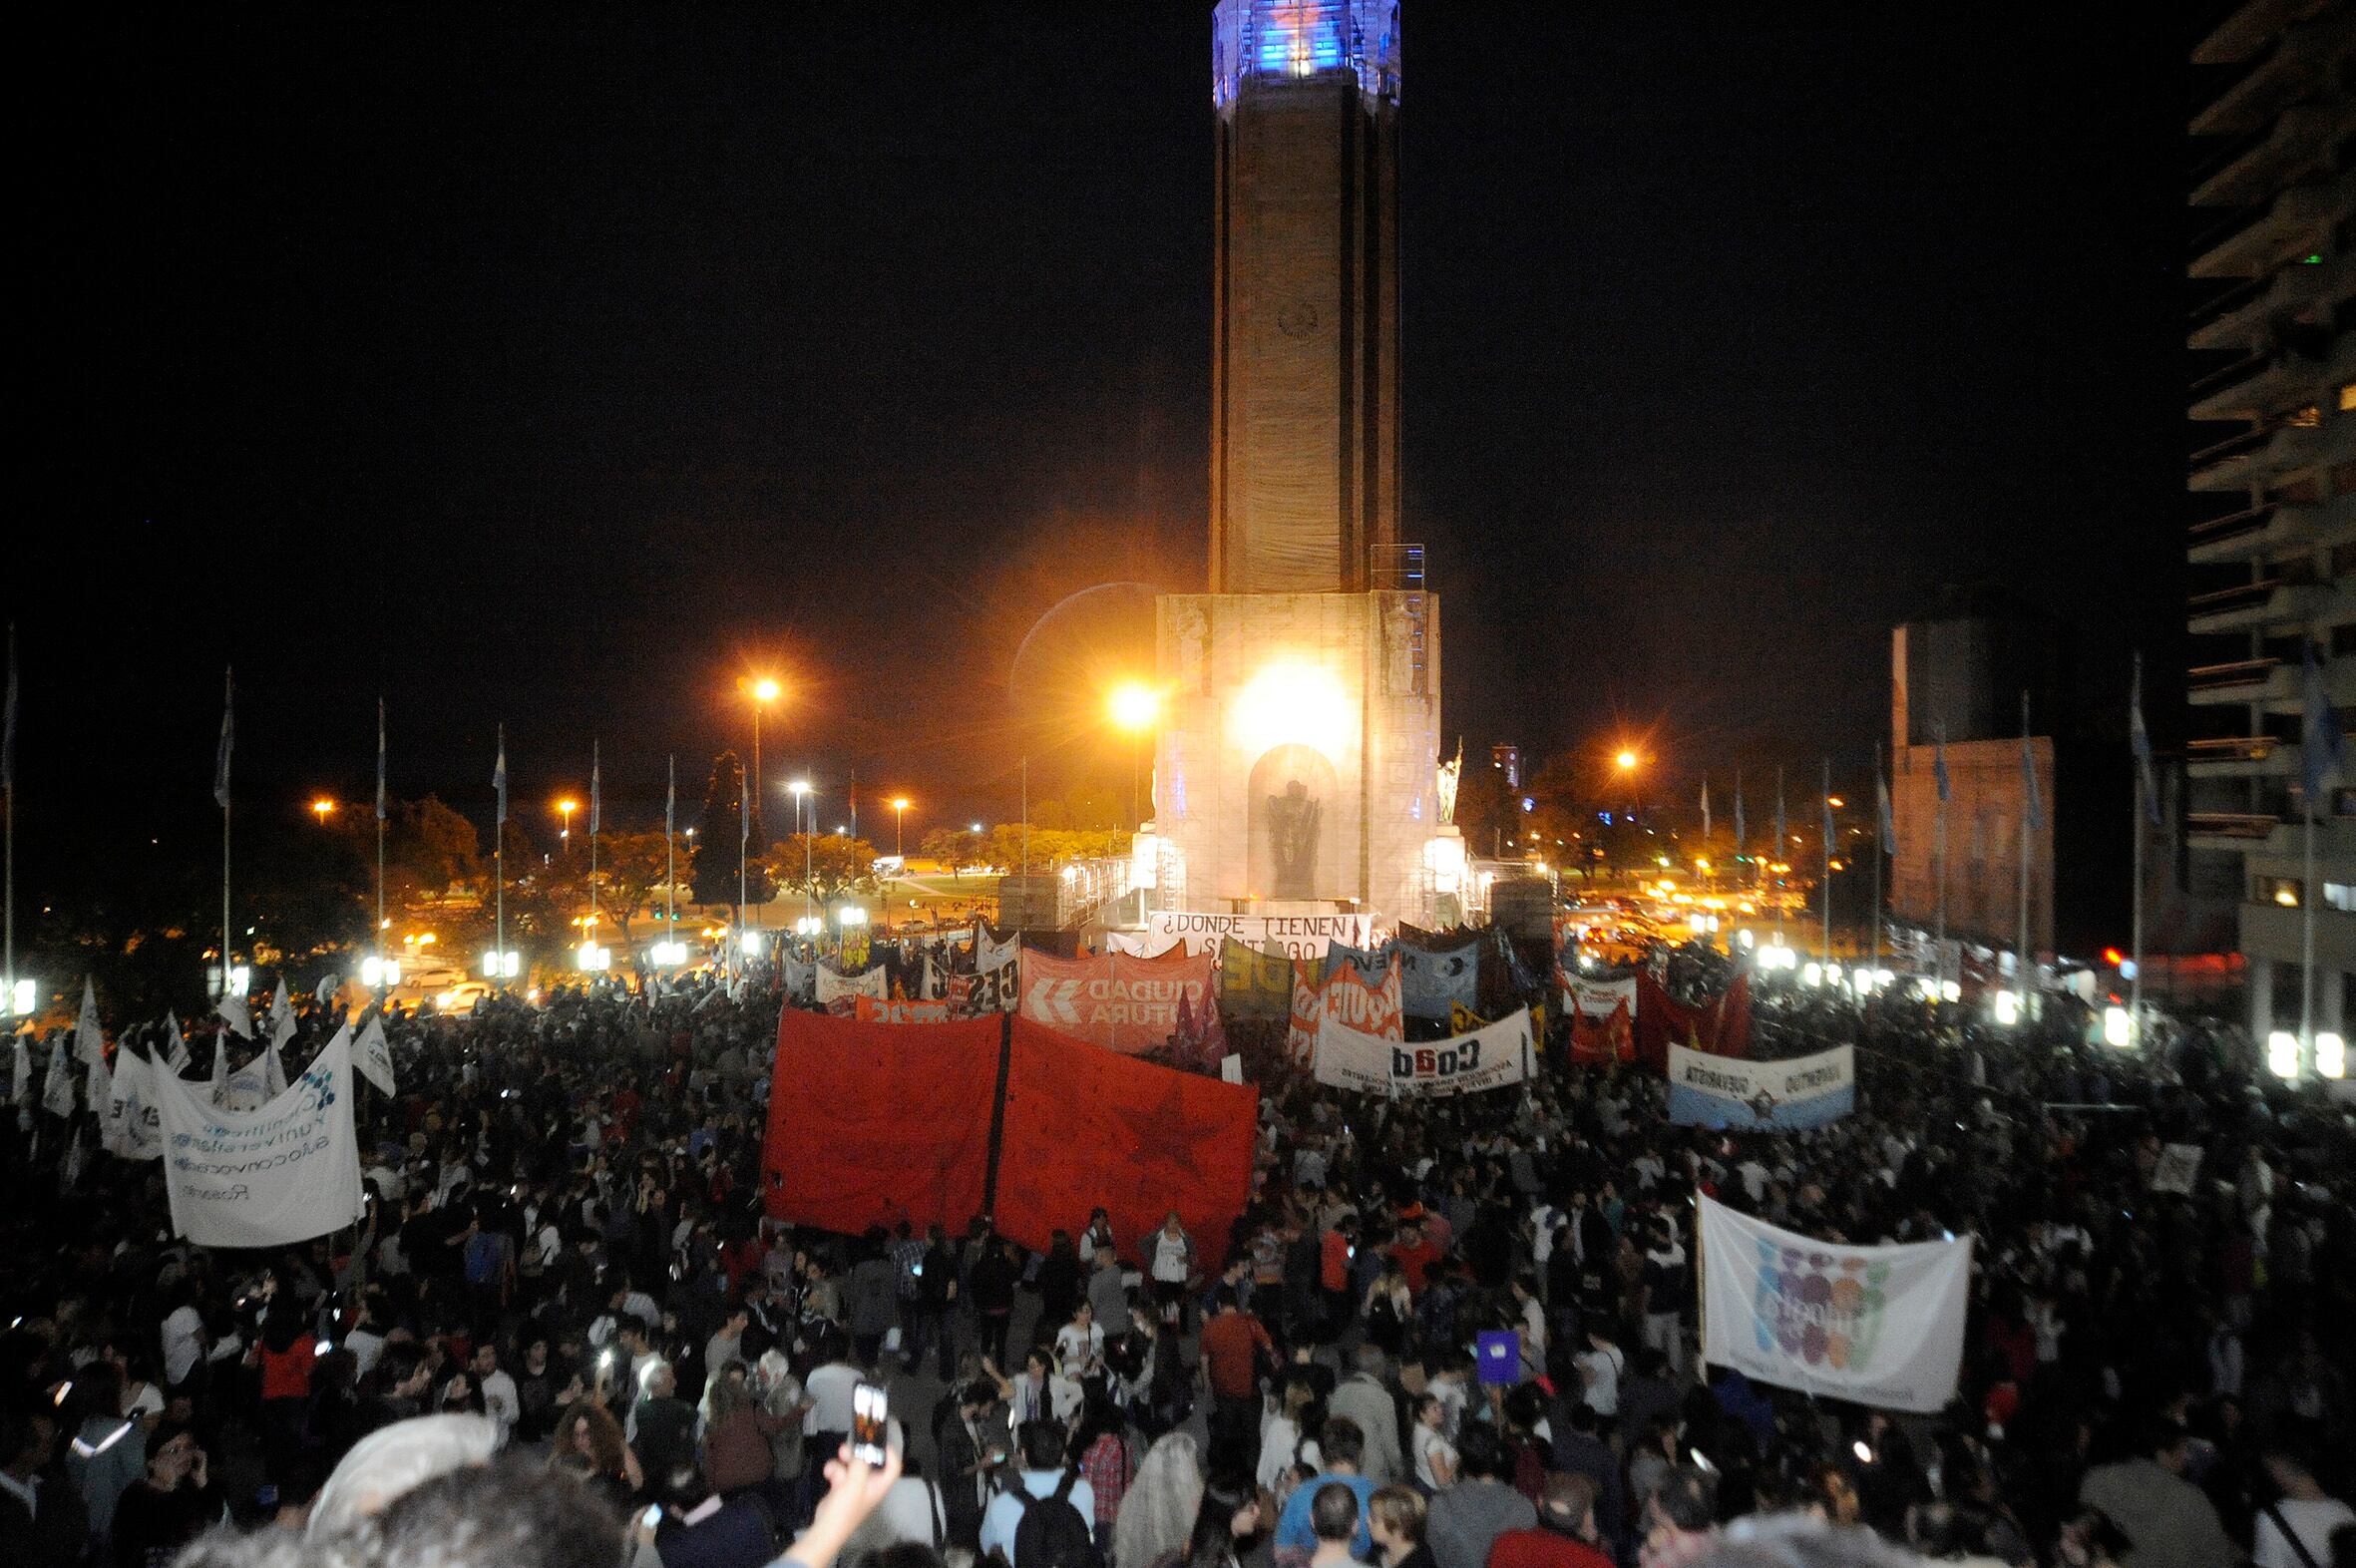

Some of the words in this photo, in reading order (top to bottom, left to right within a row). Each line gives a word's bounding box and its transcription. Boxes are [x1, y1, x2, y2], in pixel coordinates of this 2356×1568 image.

[1164, 914, 1245, 935] ¿DONDE
[1261, 916, 1347, 938] TIENEN
[1204, 937, 1317, 961] SATAGO
